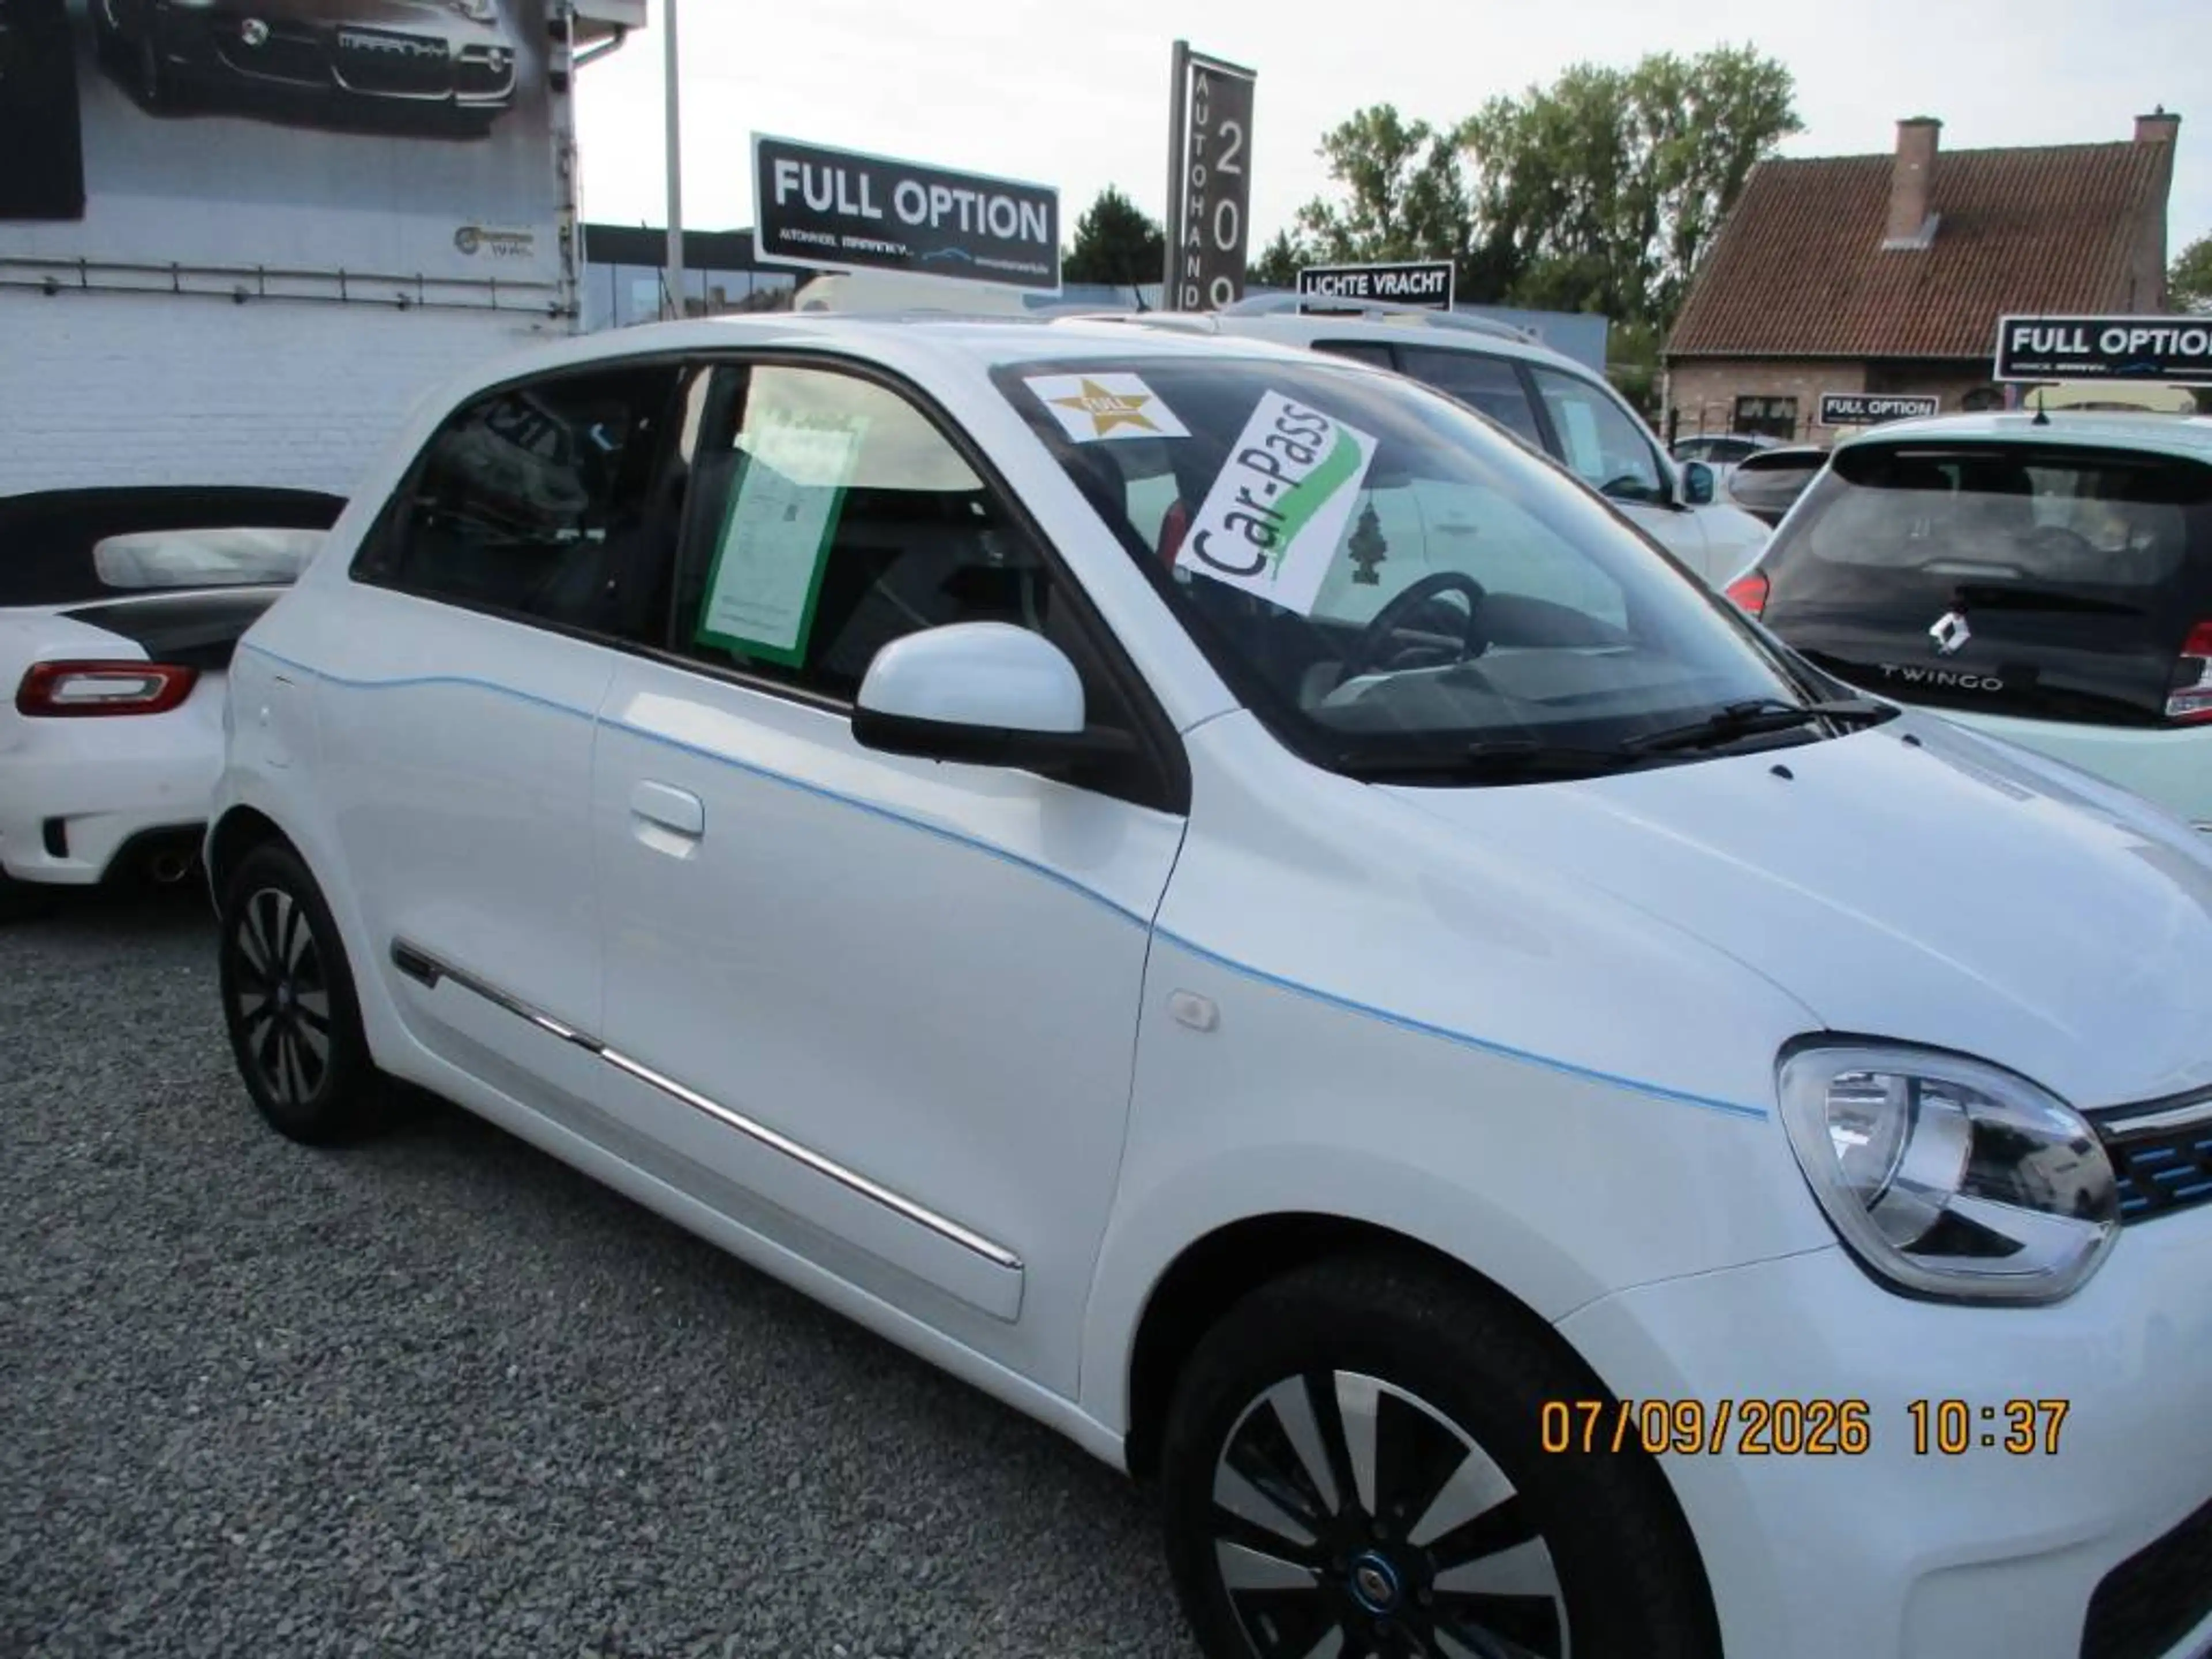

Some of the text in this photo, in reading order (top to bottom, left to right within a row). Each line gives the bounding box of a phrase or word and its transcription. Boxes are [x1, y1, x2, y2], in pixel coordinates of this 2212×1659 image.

[773, 158, 883, 220] FULL
[893, 179, 1047, 244] OPTION
[1306, 270, 1446, 296] LICHTE VRACHT
[2012, 327, 2212, 355] FULL OPTIO
[1827, 399, 1932, 416] FULL OPTION
[1191, 403, 1330, 577] Car-Pass
[1879, 662, 2004, 691] TWINGO
